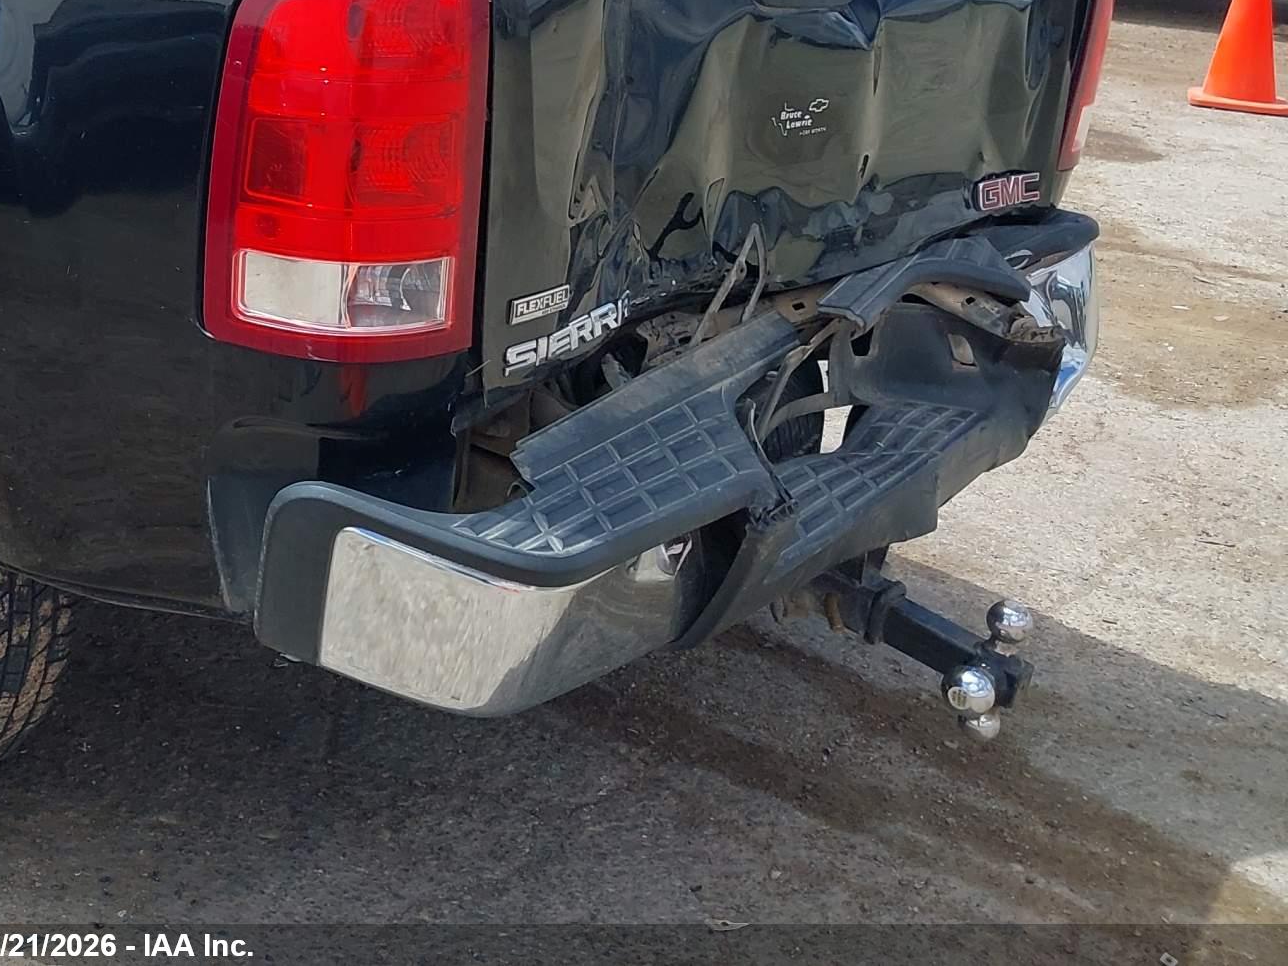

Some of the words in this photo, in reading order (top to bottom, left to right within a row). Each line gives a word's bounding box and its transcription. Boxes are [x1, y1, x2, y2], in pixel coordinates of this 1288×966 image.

[780, 111, 802, 121] Bruce
[978, 172, 1040, 211] GMC
[516, 291, 568, 317] FLEXFUEL
